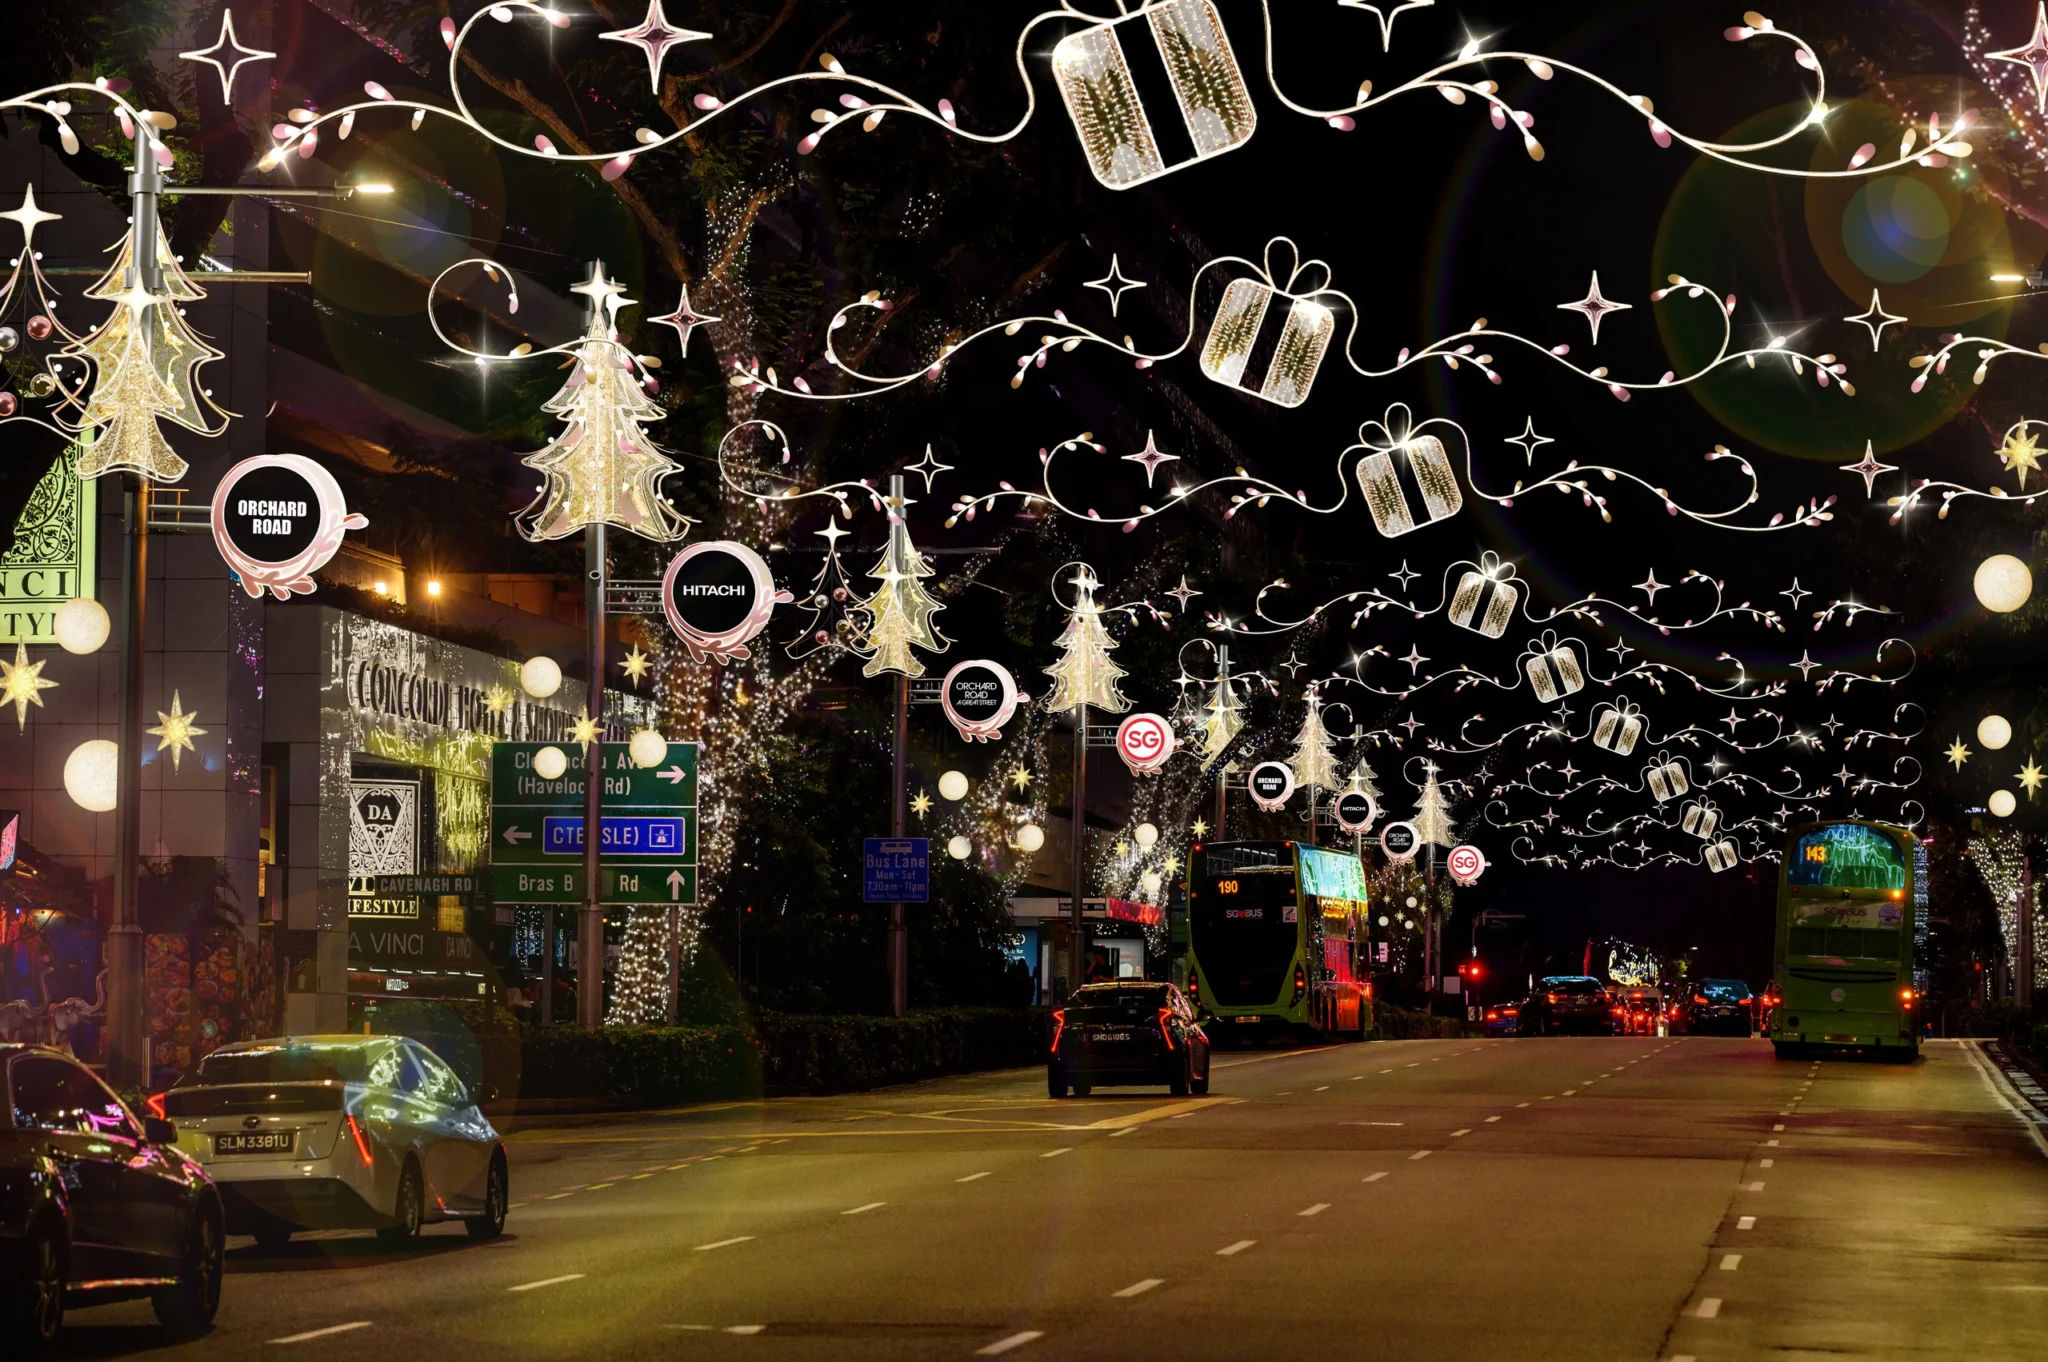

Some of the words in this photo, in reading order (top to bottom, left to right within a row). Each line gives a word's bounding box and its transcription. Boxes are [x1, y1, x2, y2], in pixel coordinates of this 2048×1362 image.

[238, 500, 307, 518] ORCHARD
[252, 518, 292, 535] ROAD
[683, 585, 745, 596] HITACHI
[956, 682, 997, 691] ORCHARD
[964, 691, 988, 699] ROAD
[1127, 731, 1159, 748] SG
[617, 752, 645, 770] Av
[518, 777, 586, 795] (Haveloc
[605, 777, 631, 796] Rd)
[367, 804, 393, 821] DA
[601, 826, 639, 846] SLE)
[867, 854, 890, 868] Bus
[895, 854, 925, 868] Lane
[1806, 846, 1825, 861] 143
[1455, 857, 1475, 869] SG
[381, 877, 450, 892] CAVENAGH
[455, 878, 472, 892] RD
[519, 874, 554, 891] Bras
[619, 875, 639, 892] Rd
[1218, 880, 1239, 894] 190
[1226, 910, 1239, 918] SG
[1245, 909, 1263, 917] BUS
[1824, 907, 1838, 916] SG
[1846, 908, 1868, 917] BUS
[370, 932, 424, 955] VINCI
[219, 1135, 289, 1149] SLM3381U
